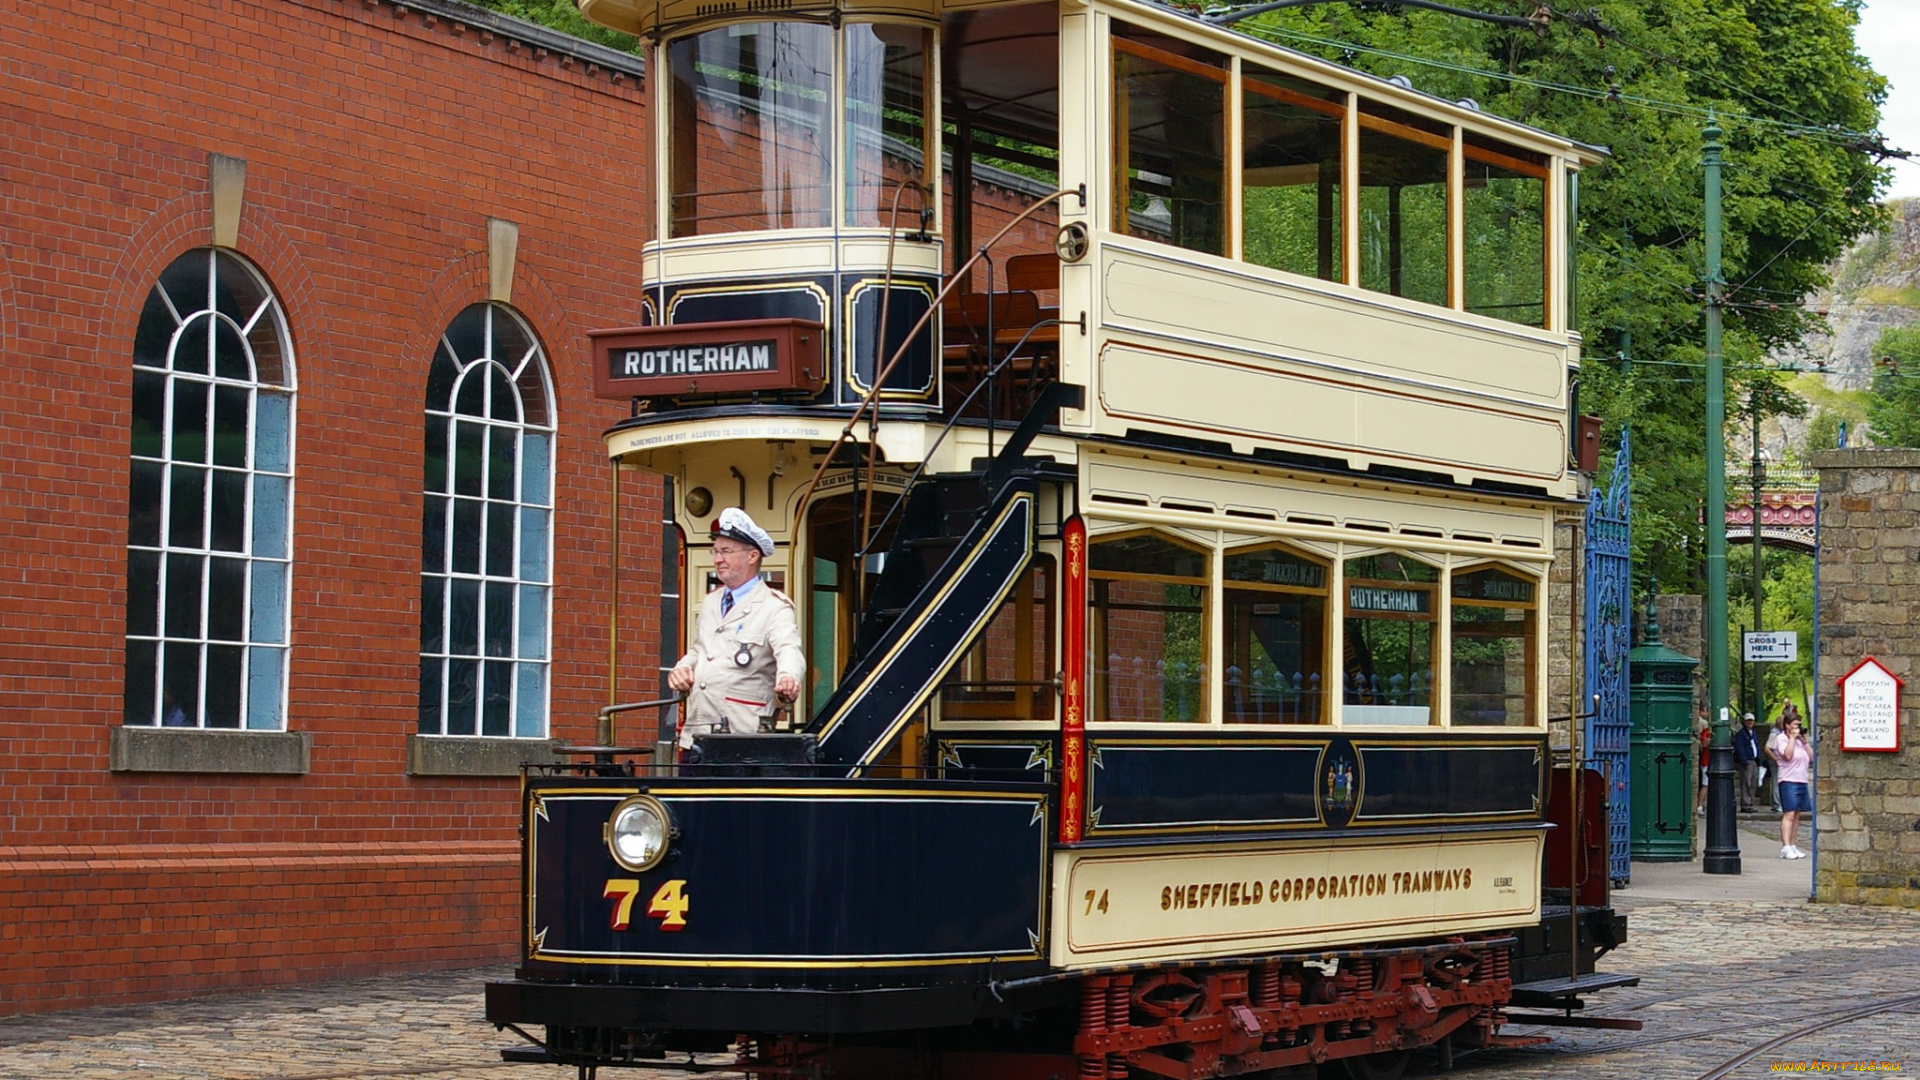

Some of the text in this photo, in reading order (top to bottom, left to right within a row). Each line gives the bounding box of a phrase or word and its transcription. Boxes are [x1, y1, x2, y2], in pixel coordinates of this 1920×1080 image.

[624, 345, 770, 375] ROTHERHAM
[1350, 587, 1418, 611] ROTHERHAM
[1084, 889, 1109, 916] 74
[1161, 867, 1472, 911] SHEFFIELD CORPORATION TRAMWAYS
[602, 879, 689, 931] 74
